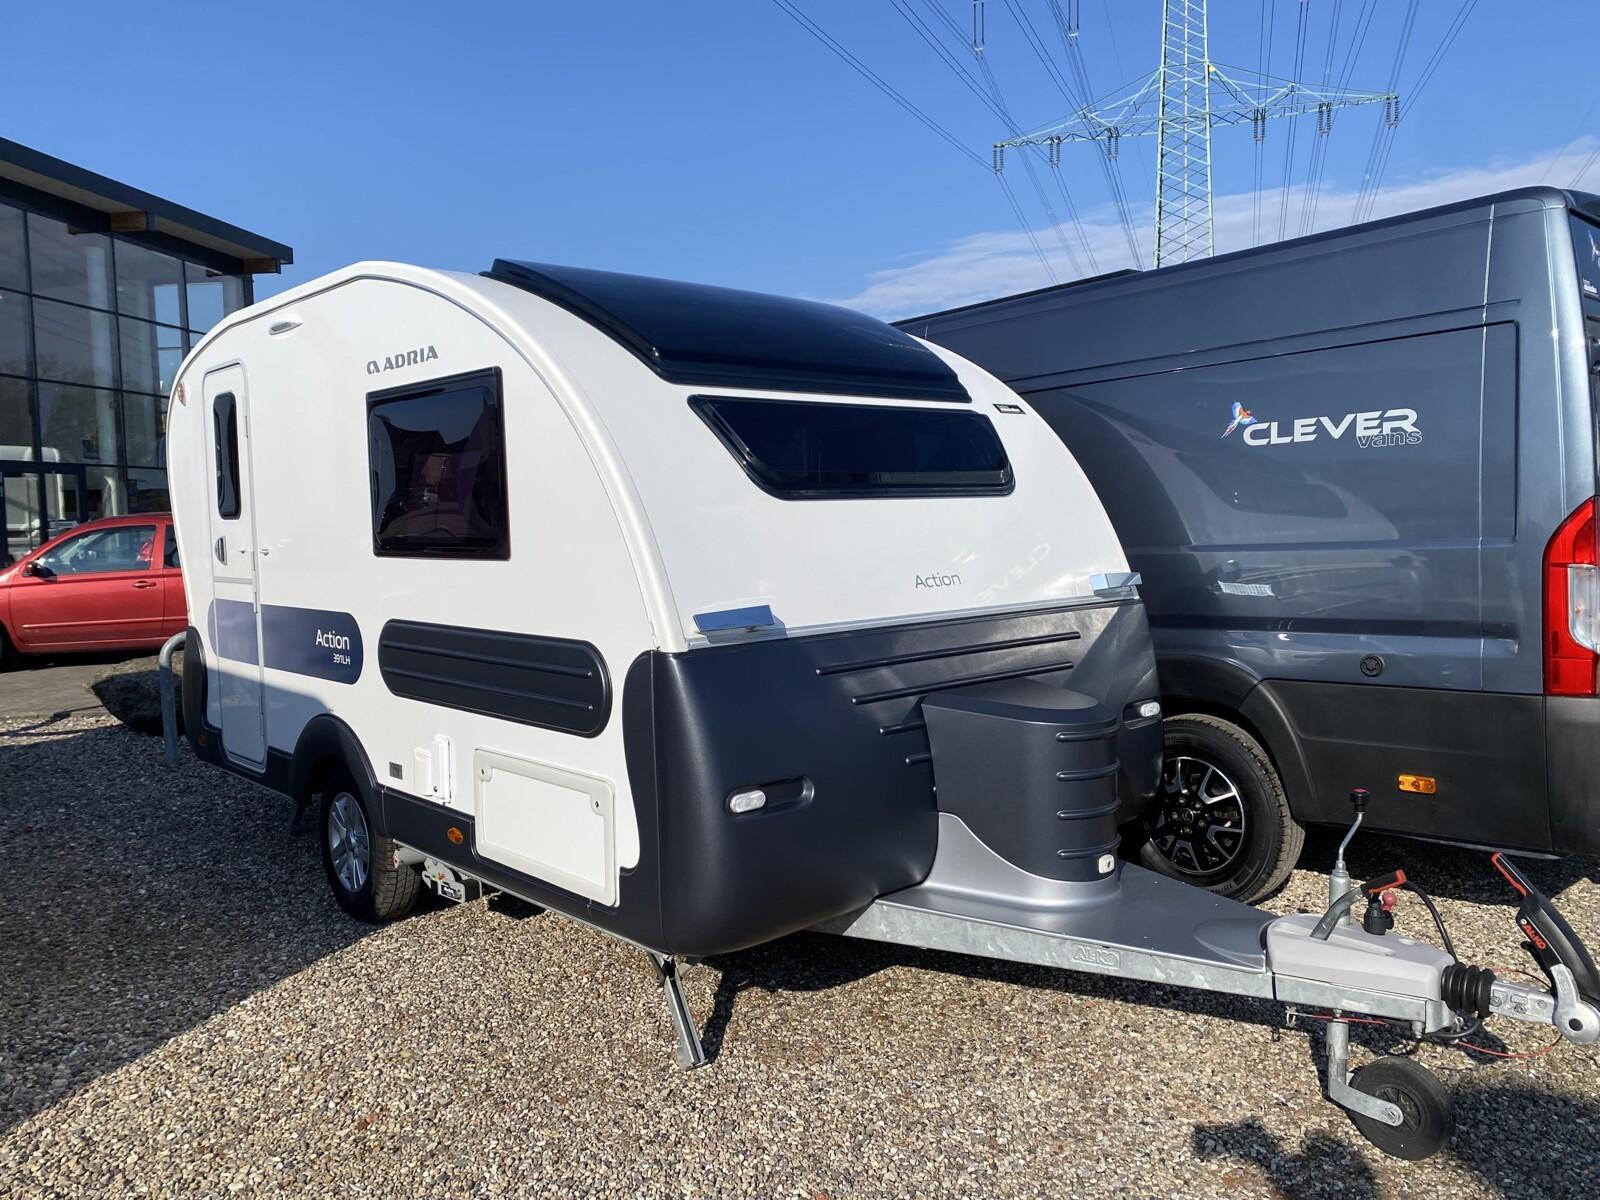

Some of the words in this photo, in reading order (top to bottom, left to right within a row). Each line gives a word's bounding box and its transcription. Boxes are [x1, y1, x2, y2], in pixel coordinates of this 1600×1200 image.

[383, 345, 439, 372] ADRIA
[1243, 408, 1419, 446] CLEVER
[1357, 430, 1423, 448] vans
[915, 572, 962, 589] Action
[315, 629, 350, 651] Action
[332, 652, 351, 665] 391LH
